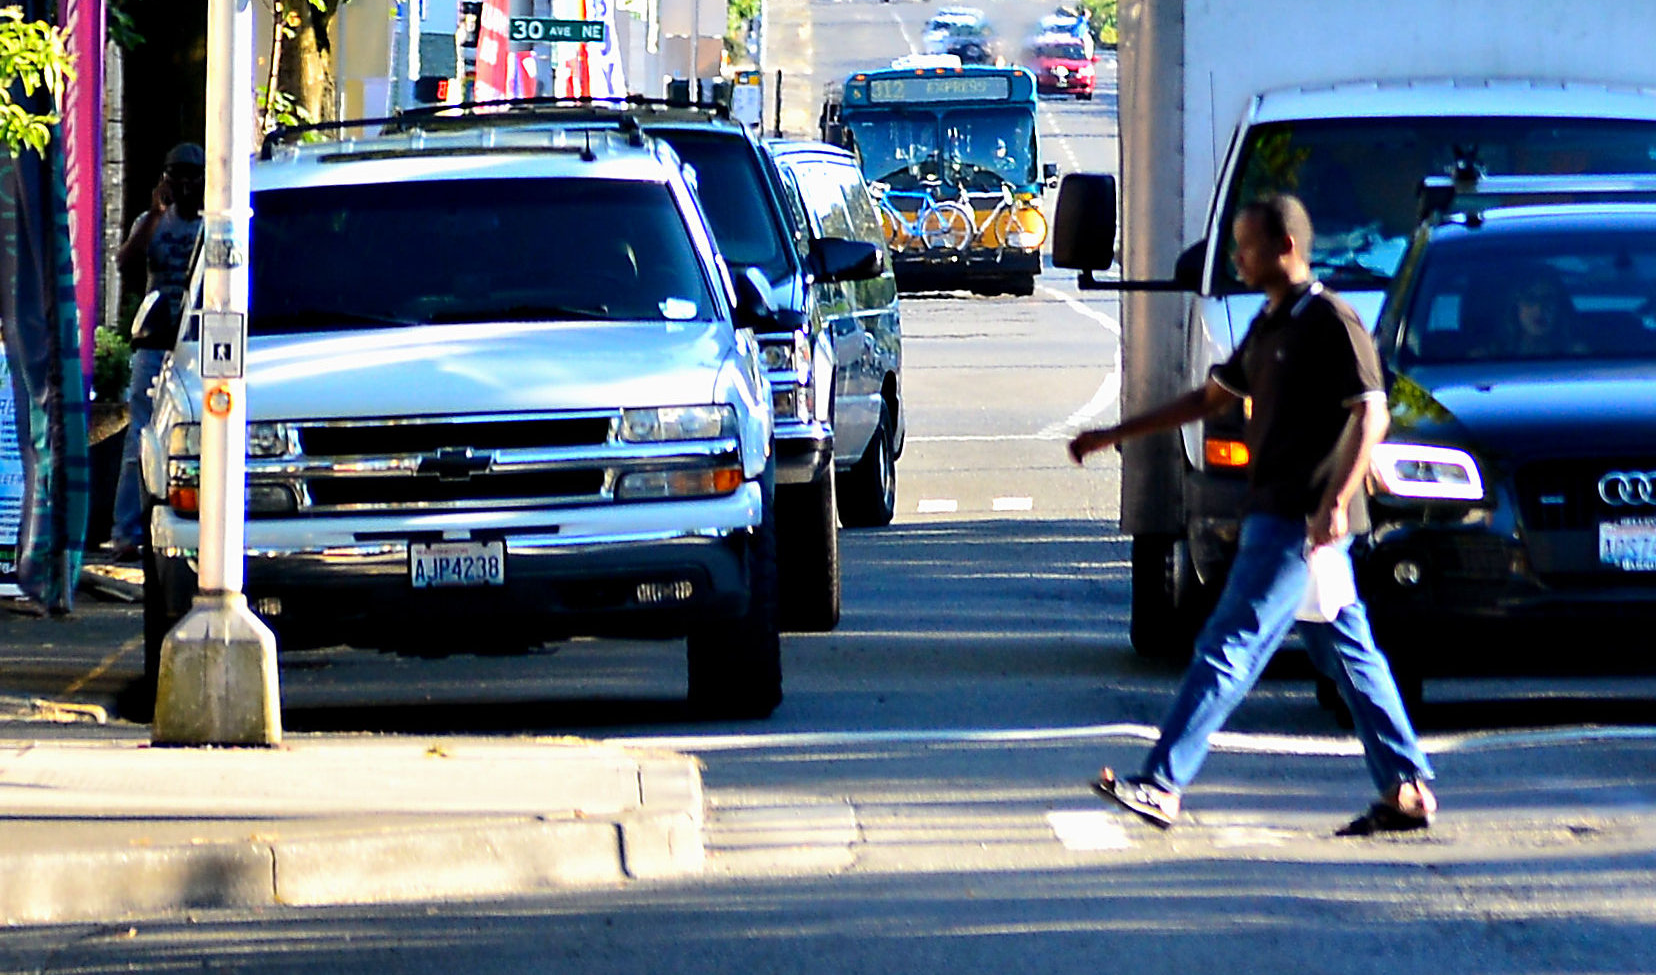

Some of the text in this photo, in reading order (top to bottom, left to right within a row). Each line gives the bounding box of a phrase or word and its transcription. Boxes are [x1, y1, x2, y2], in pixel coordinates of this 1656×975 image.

[512, 20, 602, 39] 30 AVE NE
[871, 80, 905, 100] 312
[415, 554, 500, 582] AJP4238
